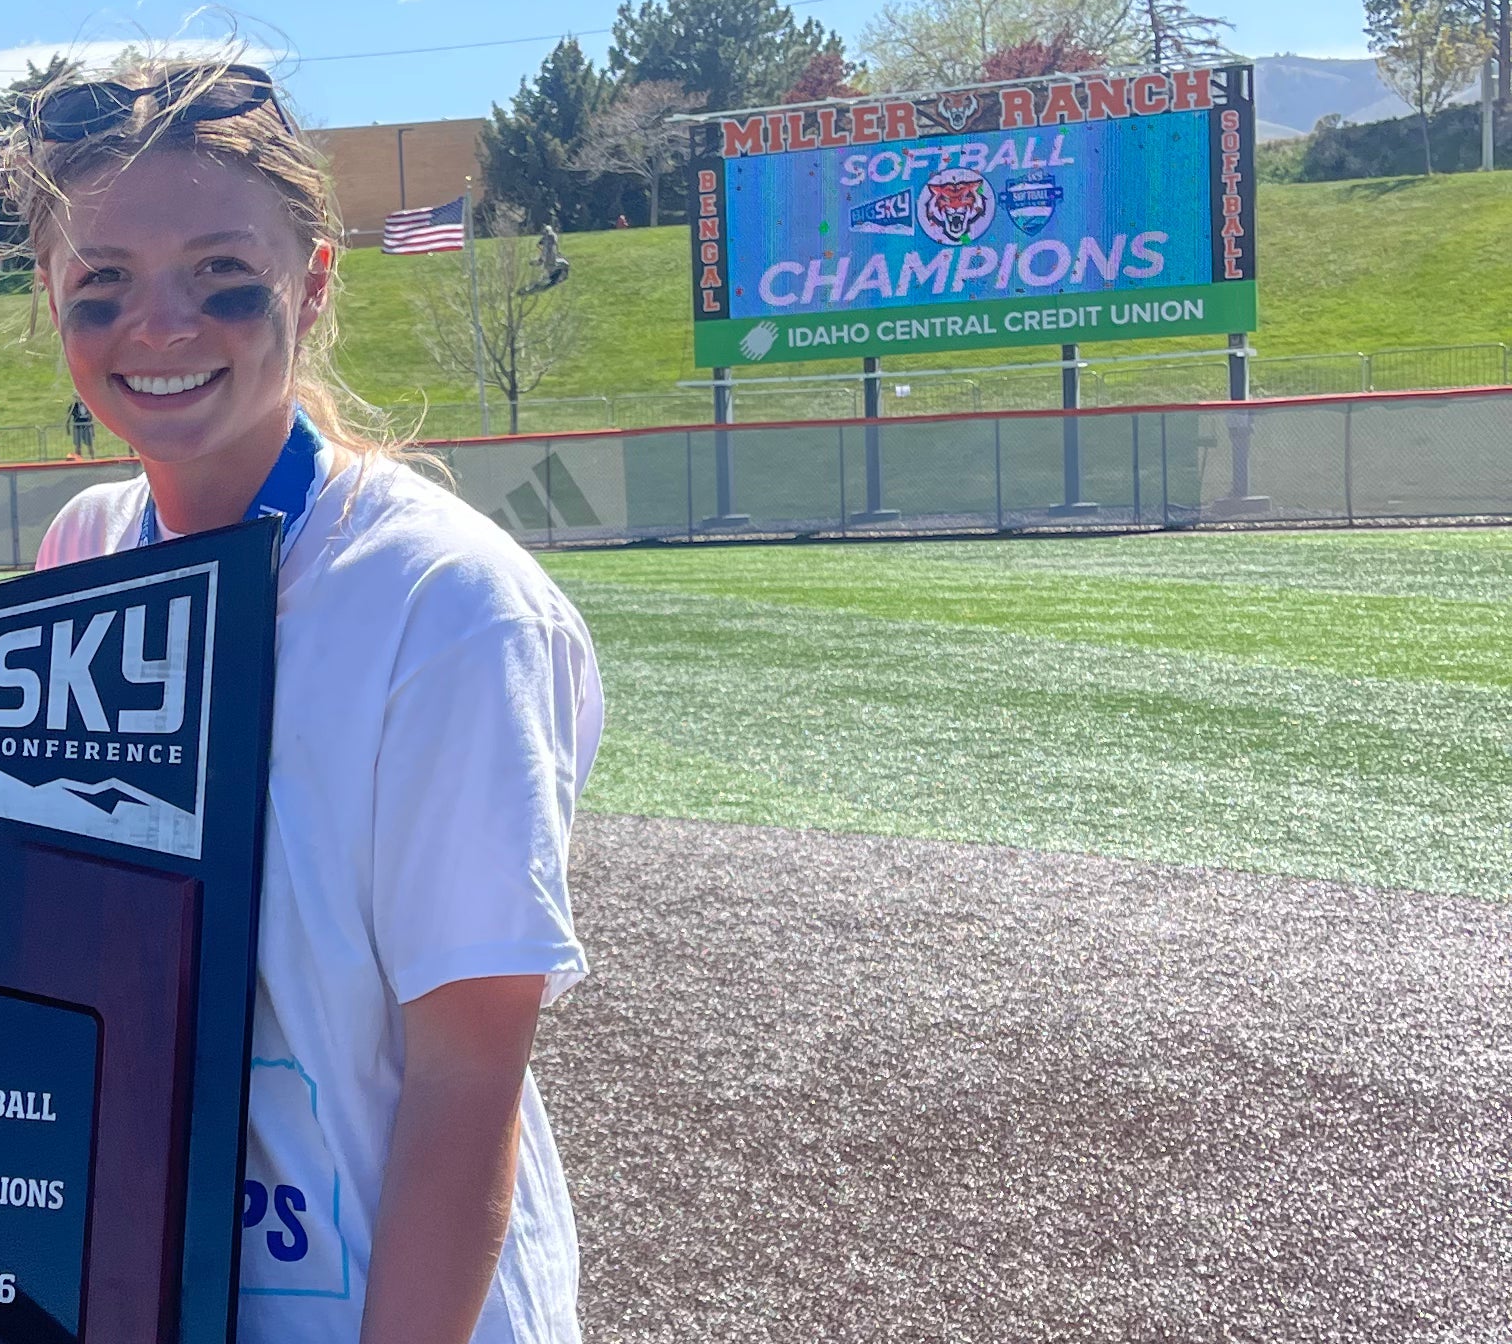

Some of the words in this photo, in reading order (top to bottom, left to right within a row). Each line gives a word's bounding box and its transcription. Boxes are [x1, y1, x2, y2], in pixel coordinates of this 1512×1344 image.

[722, 102, 918, 158] MILLER
[999, 69, 1214, 130] RANCH
[840, 134, 1074, 187] SOFTBALL
[1220, 109, 1244, 280] SOFTBALL
[697, 169, 722, 313] BENGAL
[759, 231, 1170, 308] CHAMPIONS
[788, 322, 870, 348] IDAHO
[877, 314, 997, 343] CENTRAL
[1004, 306, 1104, 333] CREDIT
[1110, 298, 1205, 326] UNION
